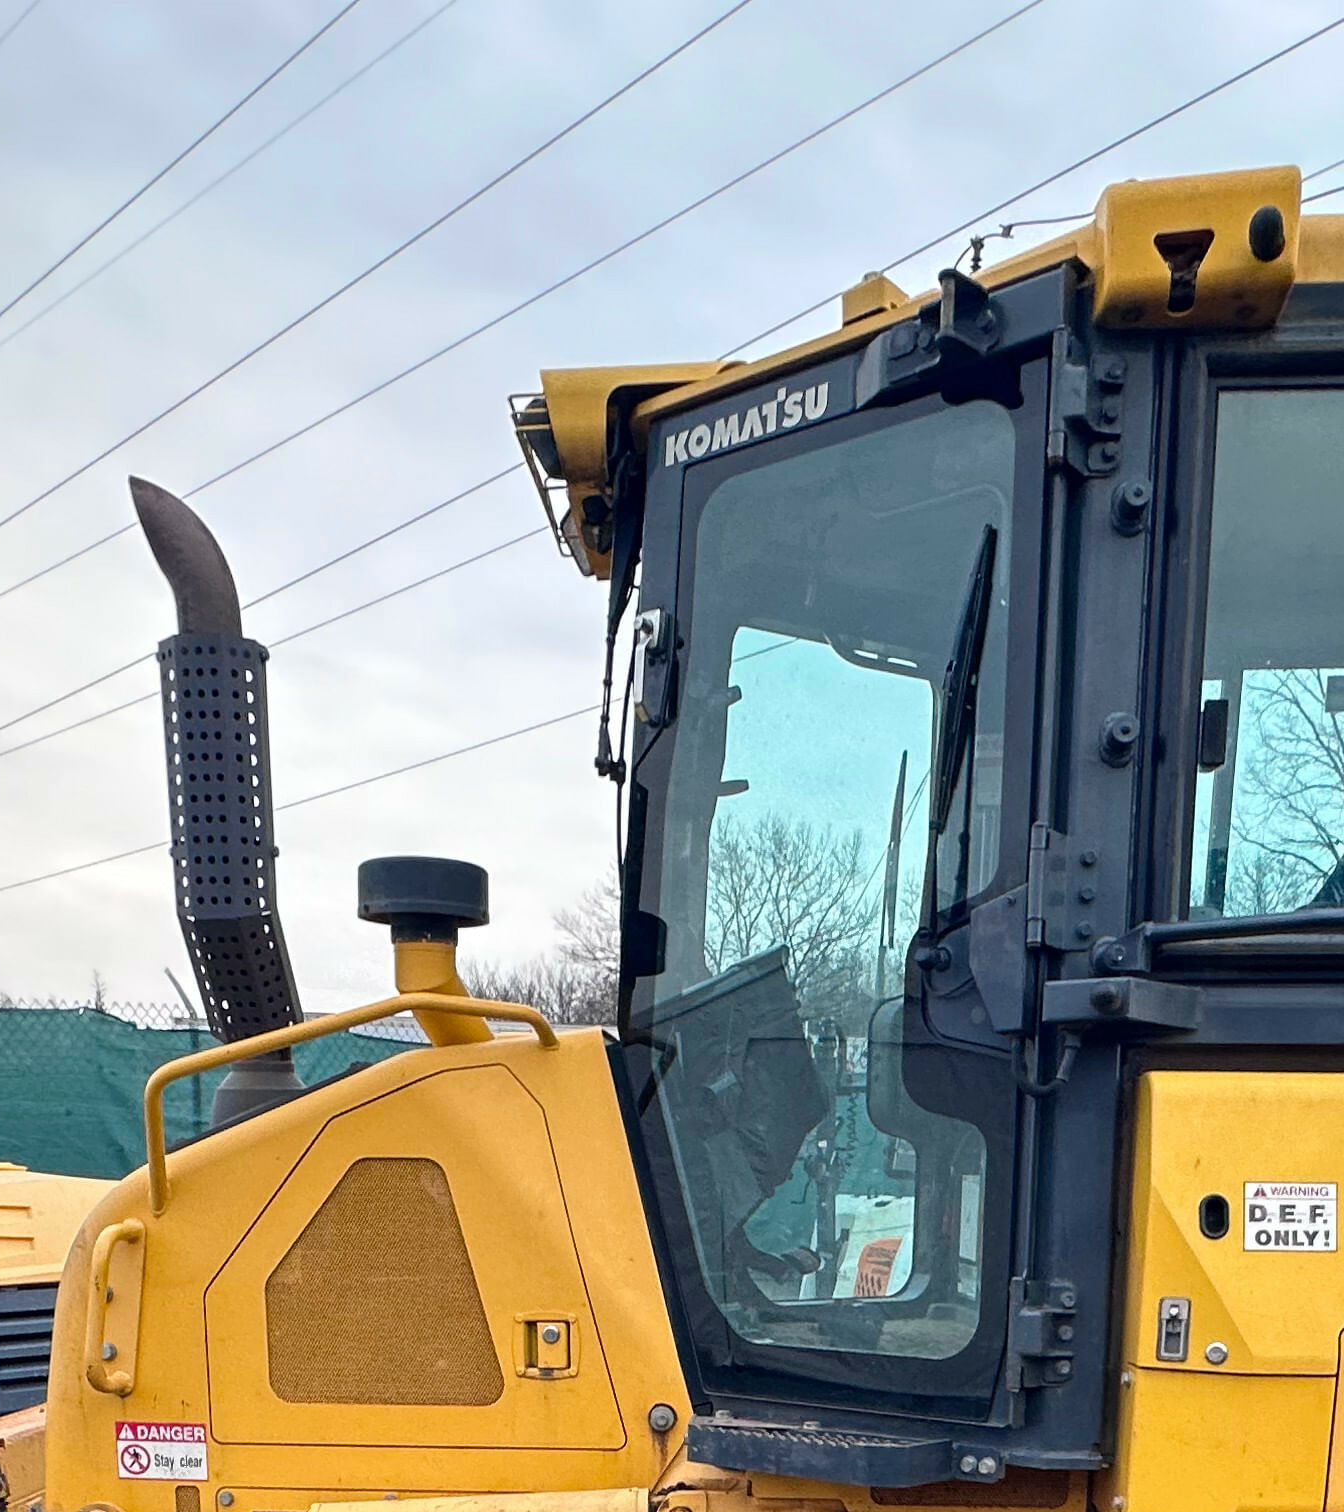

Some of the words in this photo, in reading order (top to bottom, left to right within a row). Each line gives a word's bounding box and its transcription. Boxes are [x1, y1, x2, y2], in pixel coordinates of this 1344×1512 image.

[664, 381, 829, 467] KOMATSU
[1270, 1186, 1329, 1197] WARNING
[136, 1425, 205, 1440] DANGER
[154, 1454, 175, 1472] Stay
[180, 1455, 203, 1468] clear
